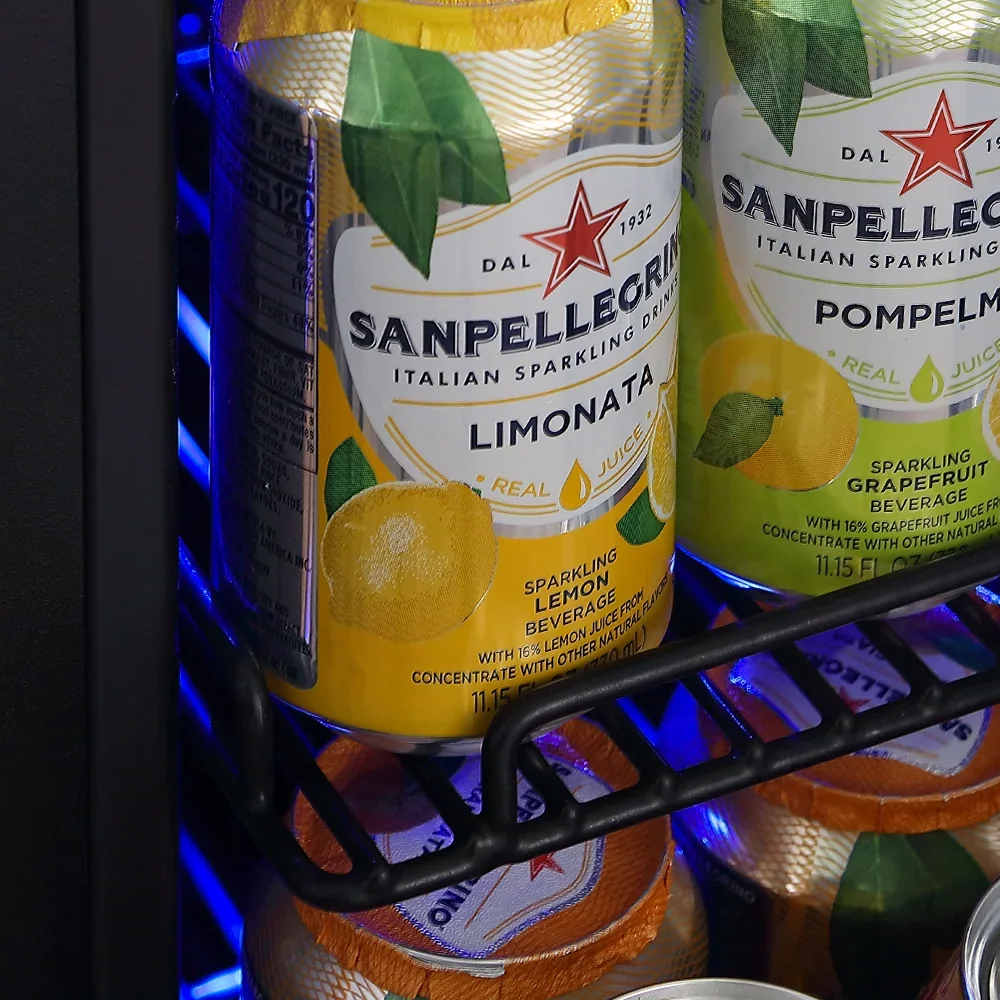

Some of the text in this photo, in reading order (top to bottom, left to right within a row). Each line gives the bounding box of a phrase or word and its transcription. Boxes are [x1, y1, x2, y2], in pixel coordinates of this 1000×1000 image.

[840, 146, 890, 164] DAL
[272, 182, 316, 224] 120
[481, 203, 653, 275] DAL 1932
[756, 234, 855, 268] ITALIAN
[868, 240, 999, 269] SPARKLING
[393, 270, 679, 388] ITALIAN SPARKLING DRINKS
[841, 357, 901, 386] REAL
[468, 362, 655, 451] LIMONATA
[490, 424, 645, 499] REAL JUICE
[846, 460, 989, 494] GRAPEFRUIT
[870, 449, 972, 474] SPARKLING
[805, 515, 841, 532] WITH
[844, 519, 867, 533] 16%
[870, 513, 951, 533] GRAPEFRUIT
[952, 503, 985, 524] JUICE
[869, 487, 969, 514] BEVERAGE
[762, 523, 861, 551] CONCENTRATE
[863, 537, 899, 551] WITH
[901, 532, 944, 549] OTHER
[946, 515, 998, 541] NATURAL
[523, 547, 618, 596] SPARKLING
[815, 554, 854, 579] 11.15
[525, 587, 617, 637] BEVERAGE
[534, 570, 610, 614] LEMON
[477, 587, 645, 665] WITH 16% LEMON JUICE FROM
[411, 663, 517, 685] CONCENTRATE
[519, 655, 555, 676] WITH
[557, 639, 597, 667] OTHER
[599, 615, 642, 650] NATURAL
